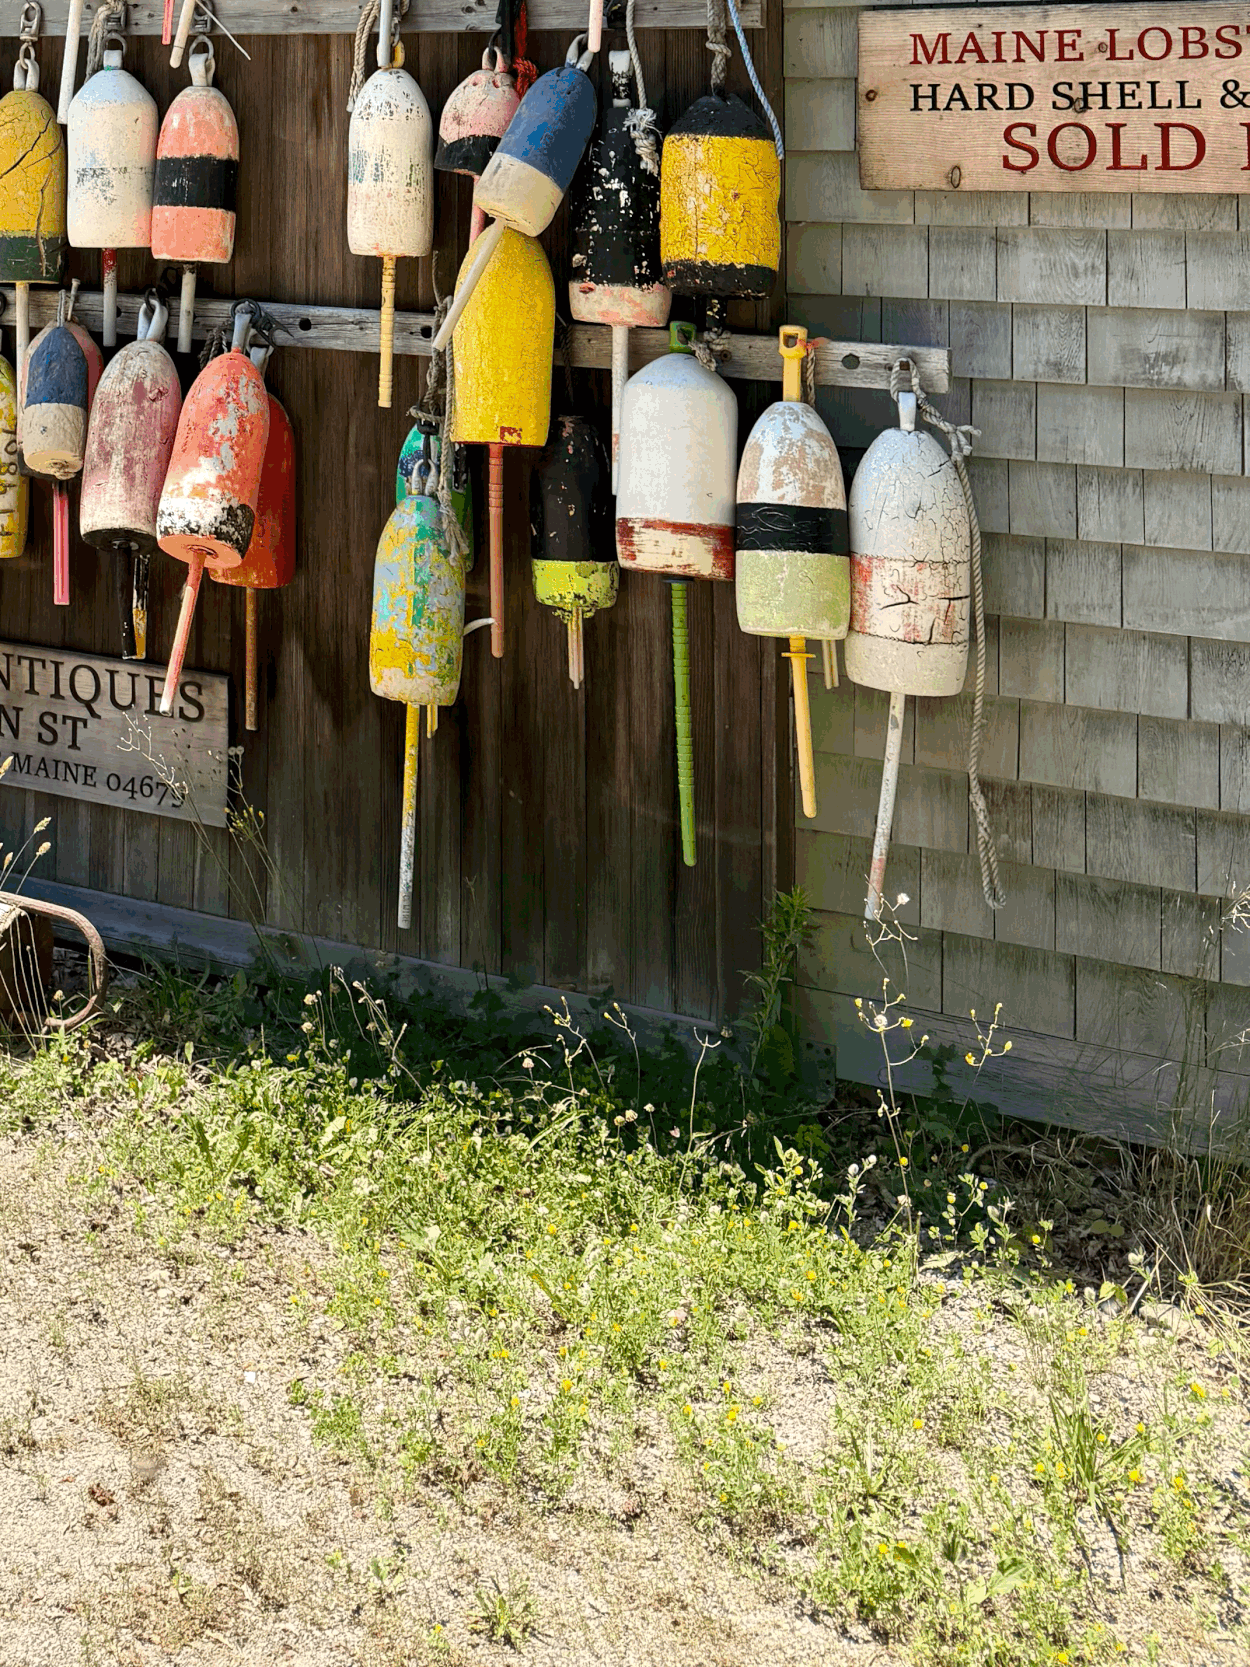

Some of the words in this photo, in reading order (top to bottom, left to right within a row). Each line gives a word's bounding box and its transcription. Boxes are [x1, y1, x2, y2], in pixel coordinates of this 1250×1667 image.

[909, 28, 1085, 65] MAINE
[1105, 24, 1250, 61] LOBS
[910, 81, 1035, 112] HARD
[1052, 79, 1202, 110] SHELL
[1219, 79, 1250, 109] &
[1002, 121, 1207, 172] SOLD
[37, 711, 88, 751] ST
[11, 752, 97, 788] MAINE
